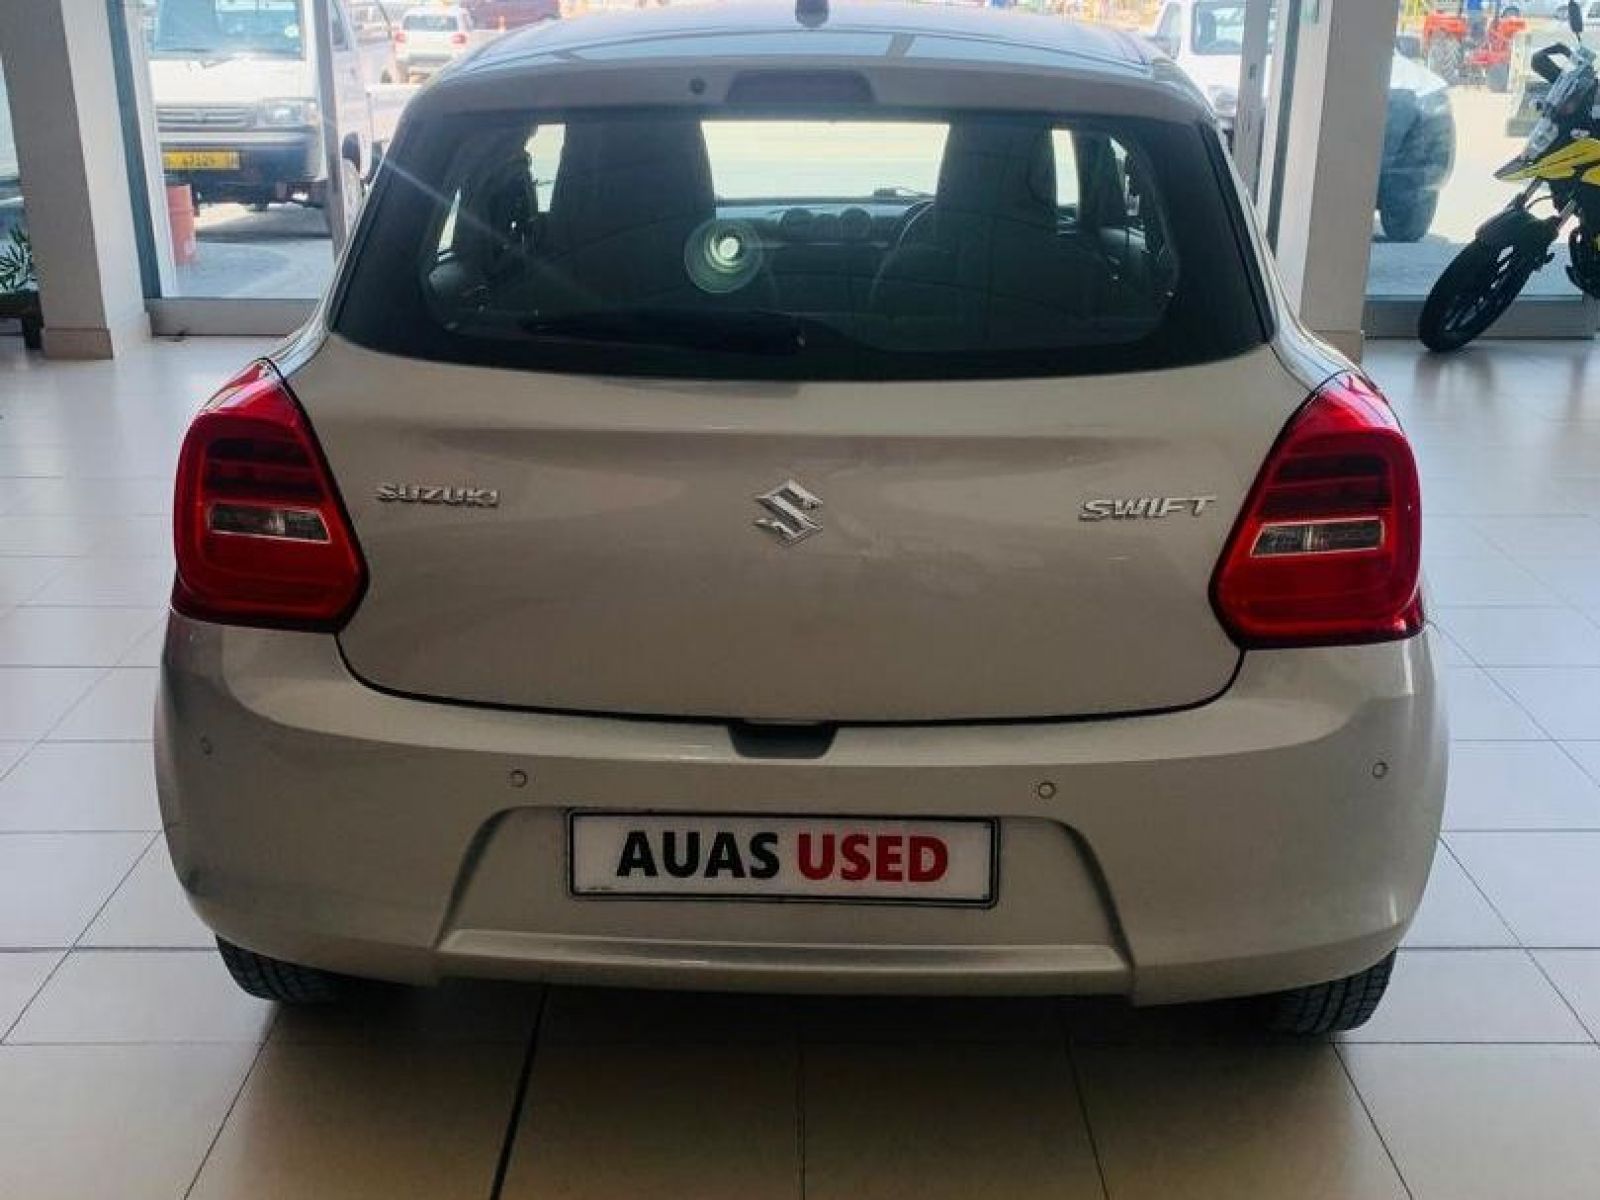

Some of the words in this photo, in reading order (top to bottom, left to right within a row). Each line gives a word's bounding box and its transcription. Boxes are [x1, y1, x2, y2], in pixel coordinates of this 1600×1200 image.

[376, 484, 499, 507] SUZUKI
[1079, 495, 1217, 521] SWIFT
[616, 831, 780, 878] AUAS
[797, 833, 948, 882] USED
